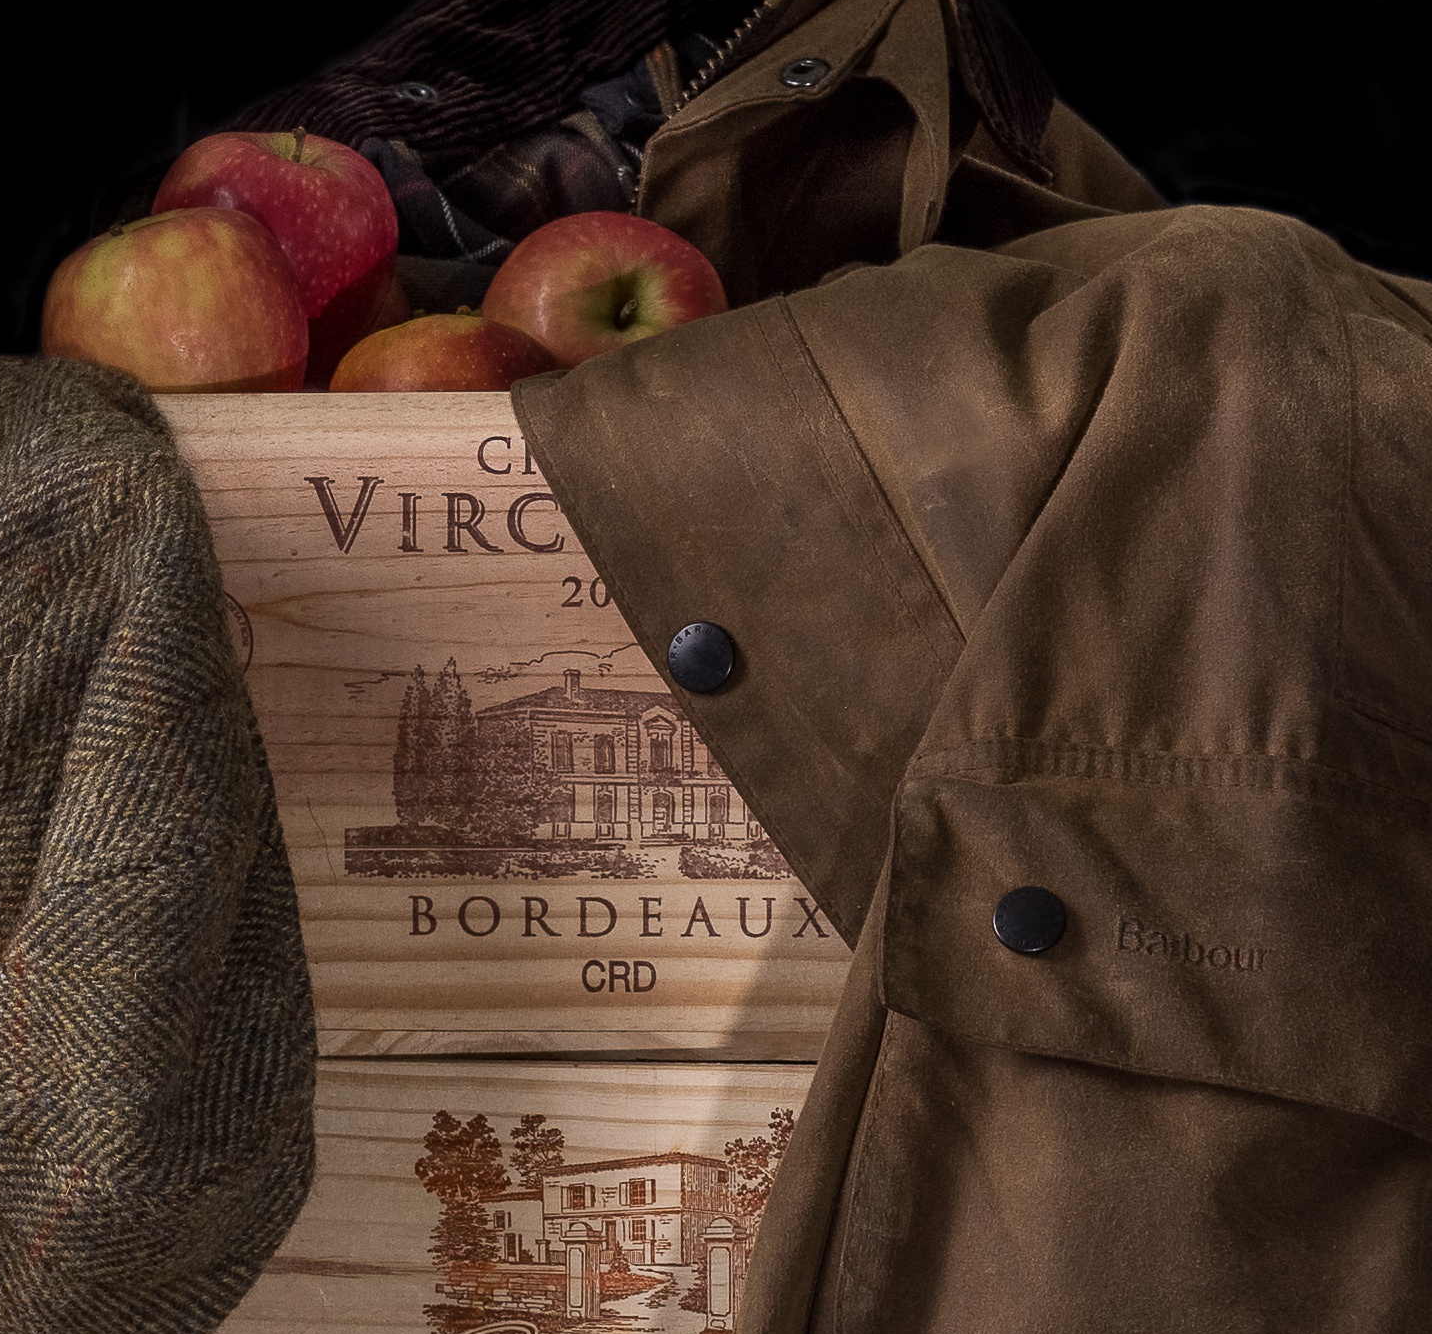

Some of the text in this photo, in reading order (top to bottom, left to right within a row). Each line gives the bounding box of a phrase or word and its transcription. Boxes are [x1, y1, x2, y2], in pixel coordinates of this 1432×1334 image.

[408, 896, 831, 938] BORDEAUX
[1116, 917, 1273, 972] Barbour
[581, 960, 657, 994] CRD
